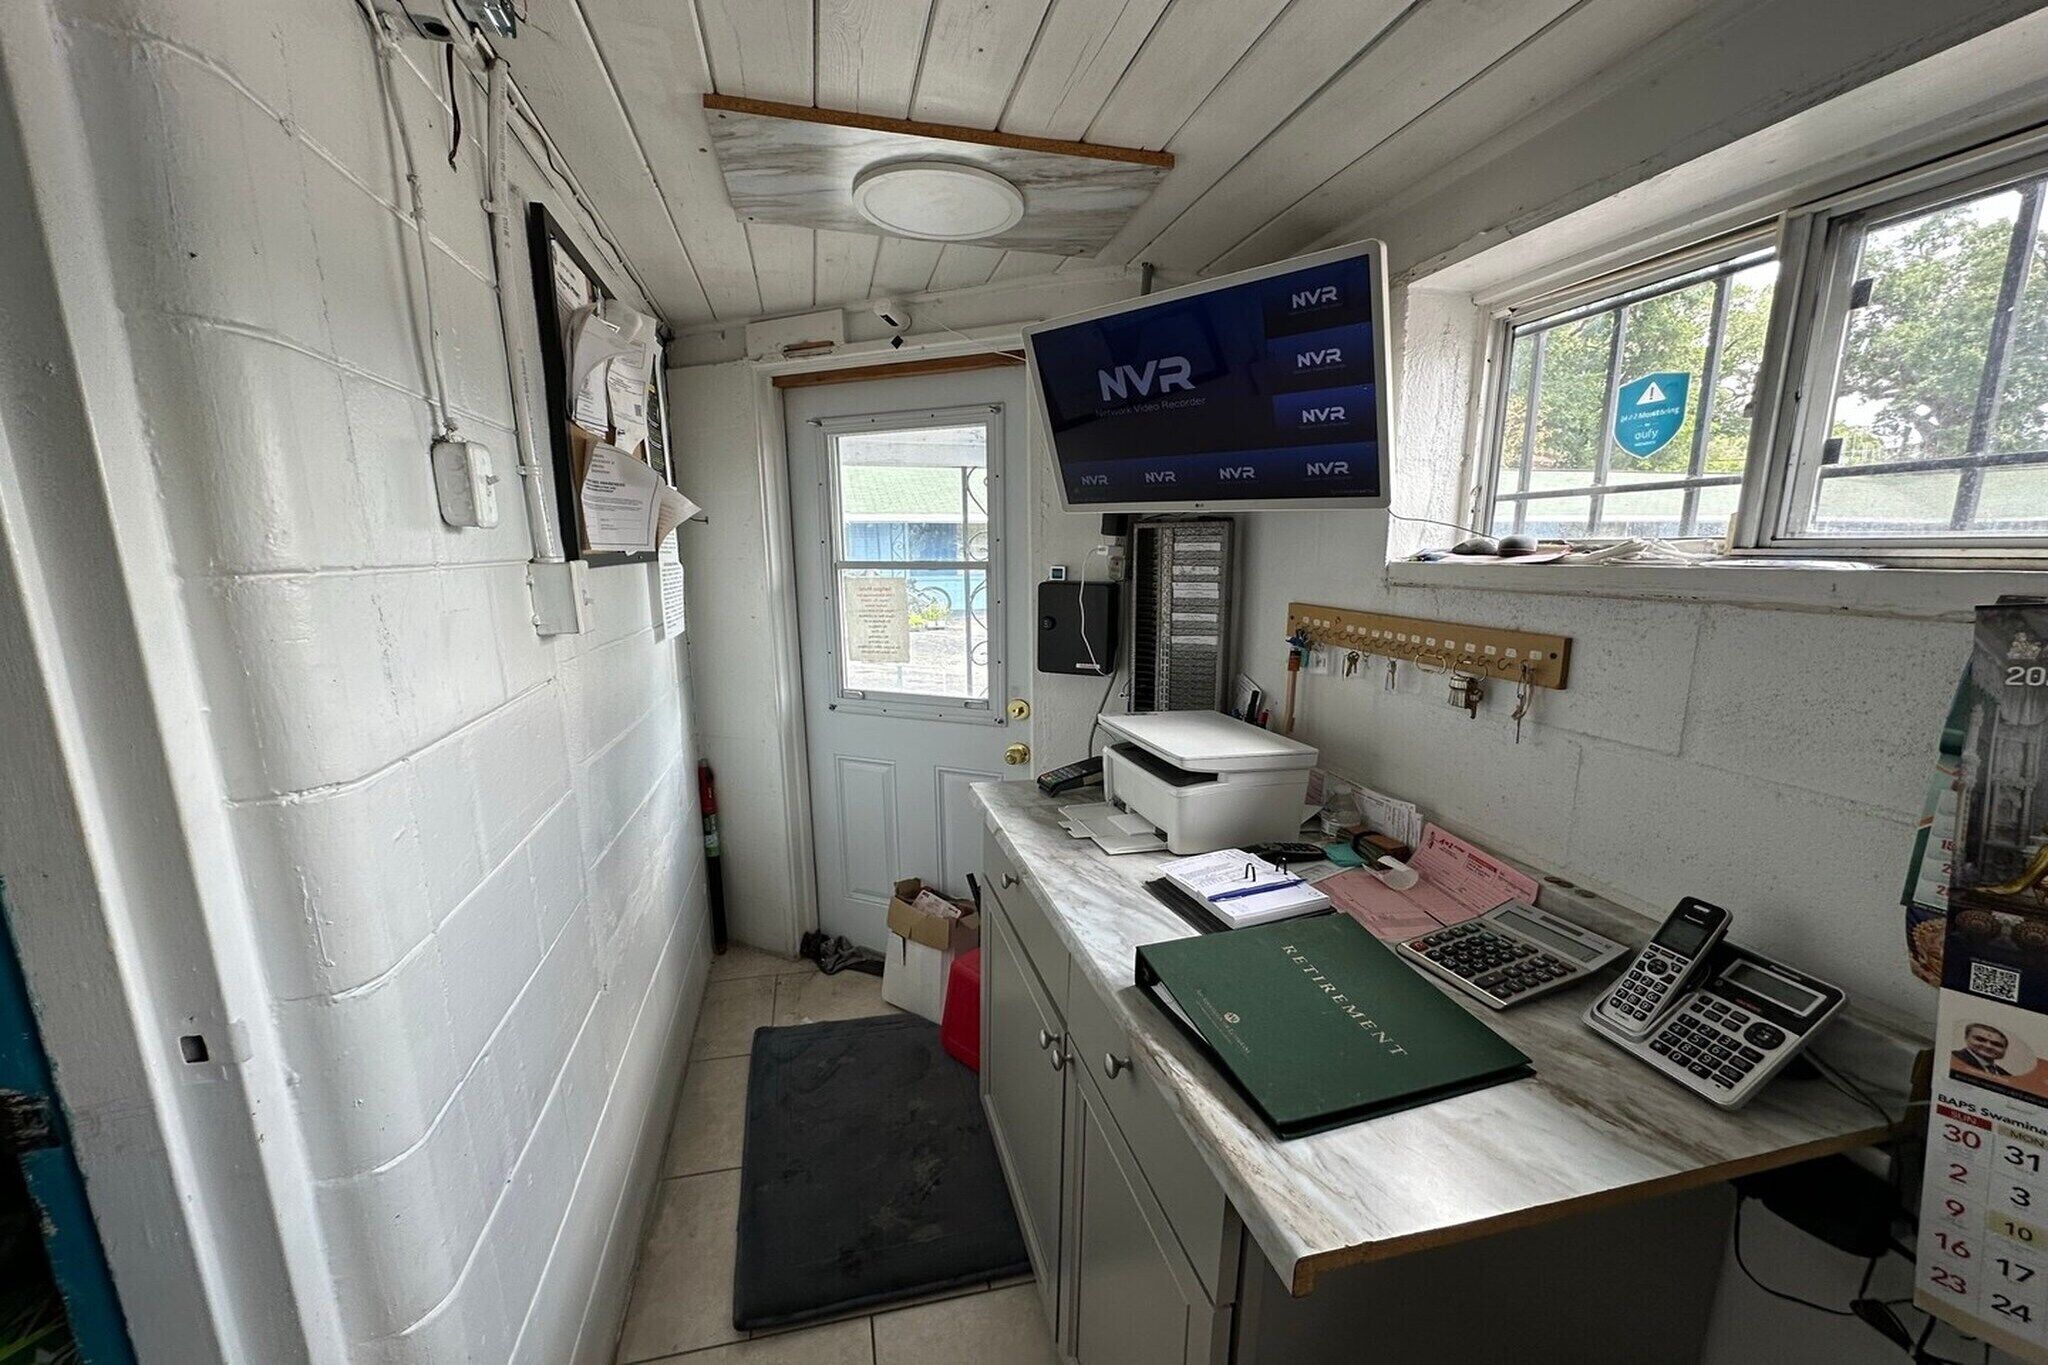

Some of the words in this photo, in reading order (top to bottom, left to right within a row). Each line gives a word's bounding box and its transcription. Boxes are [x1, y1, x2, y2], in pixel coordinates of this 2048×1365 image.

[1291, 285, 1338, 310] NVR
[1098, 356, 1196, 401] NVR
[1297, 348, 1342, 369] NVR
[1134, 402, 1159, 413] Video
[1161, 396, 1208, 411] Recorder
[1302, 406, 1346, 424] NVR
[1081, 474, 1108, 487] NVR
[1145, 470, 1177, 483] NVR
[1219, 466, 1255, 480] NVR
[1306, 461, 1350, 477] NVR
[2005, 666, 2048, 686] 20
[1281, 944, 1408, 1057] RETIREMENT
[1938, 1093, 1976, 1112] BAPS
[1943, 1123, 1981, 1150] 30
[2004, 1145, 2041, 1172] 31
[1949, 1109, 1979, 1125] SUN
[2009, 1129, 2047, 1149] MON
[1949, 1163, 1968, 1184] 2
[2010, 1186, 2031, 1207] 3
[1945, 1199, 1966, 1218] 9
[2004, 1222, 2034, 1243] 10
[1934, 1232, 1971, 1260] 16
[1996, 1258, 2035, 1284] 17
[1930, 1266, 1967, 1295] 23
[1991, 1293, 2032, 1324] 24
